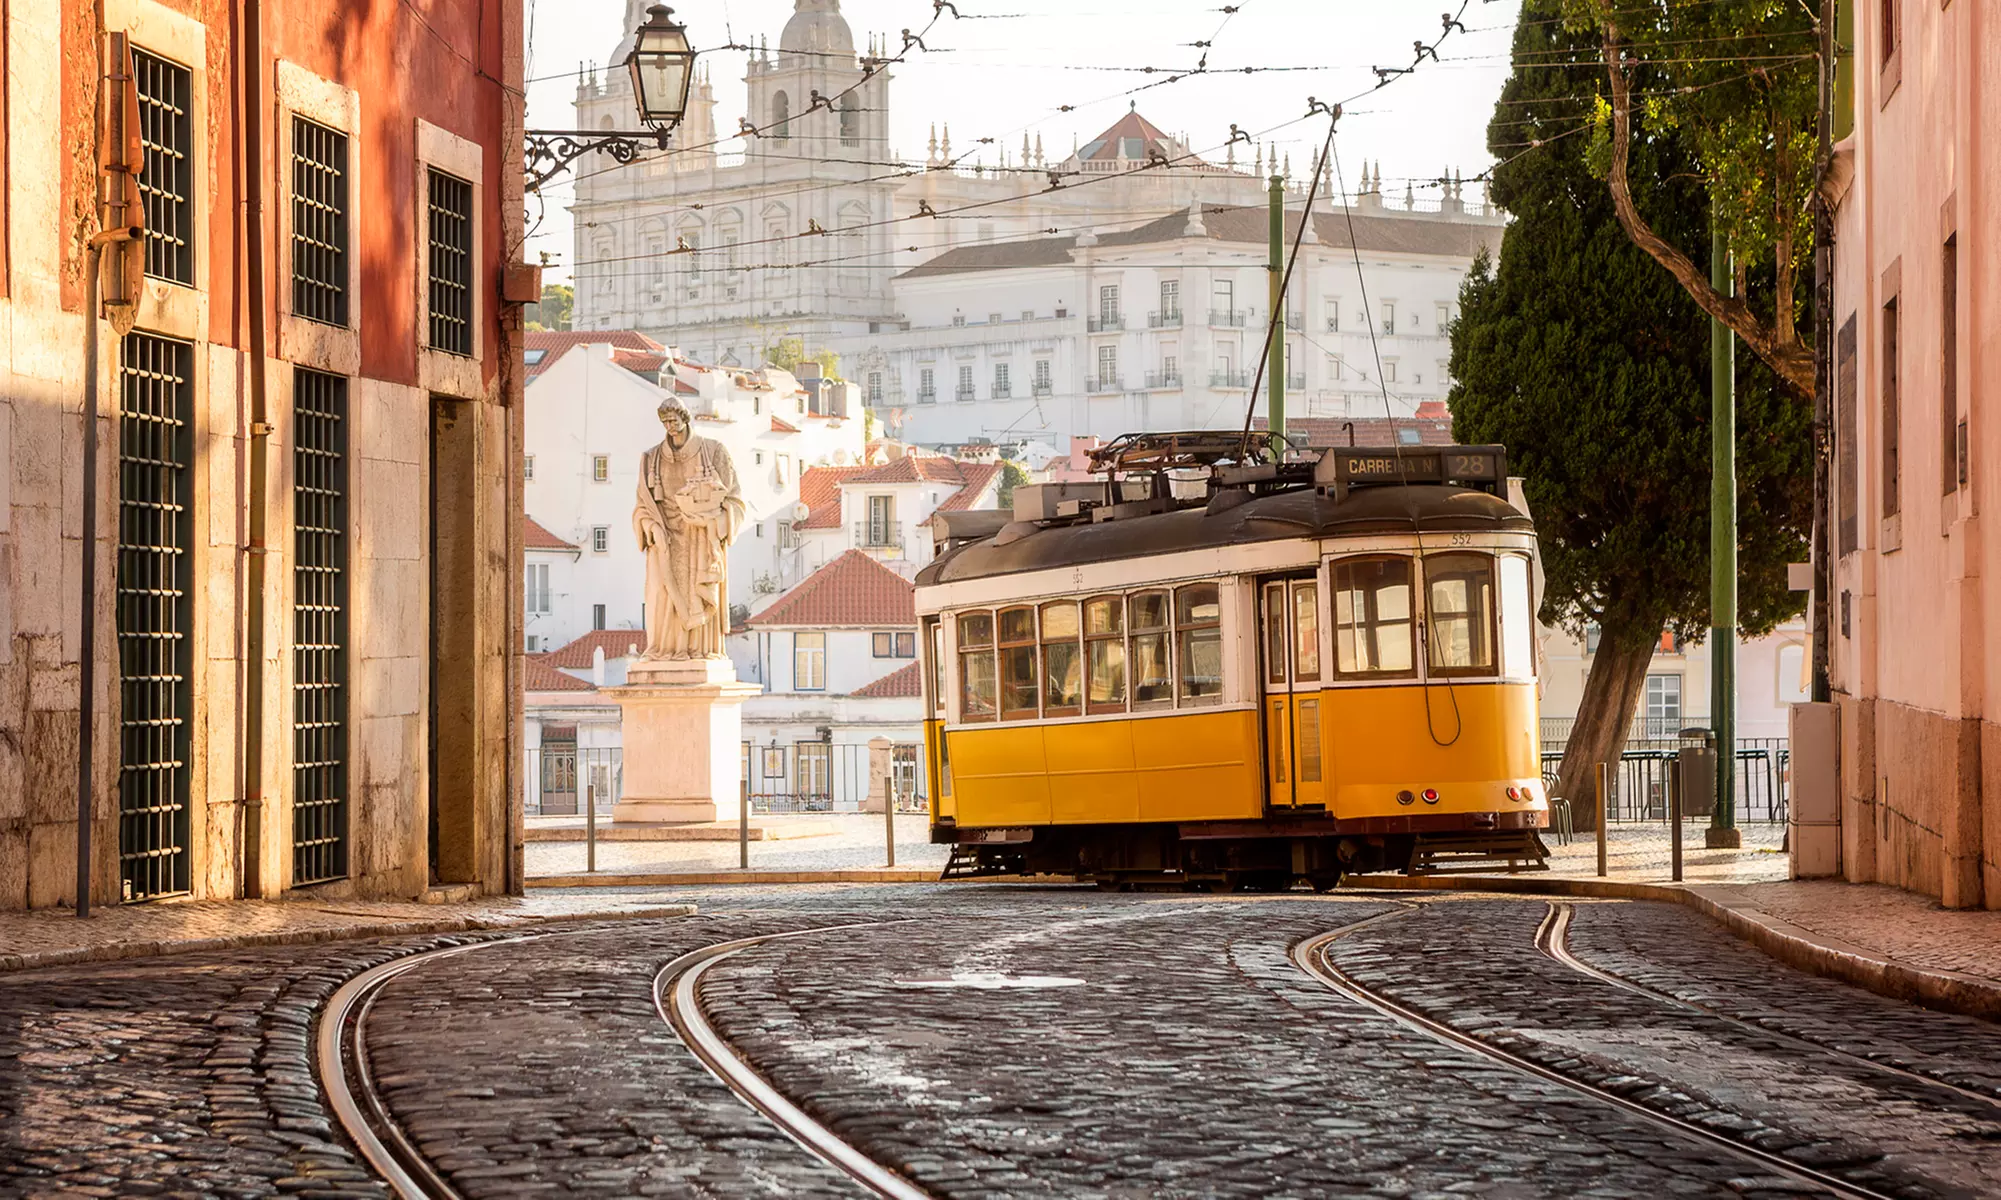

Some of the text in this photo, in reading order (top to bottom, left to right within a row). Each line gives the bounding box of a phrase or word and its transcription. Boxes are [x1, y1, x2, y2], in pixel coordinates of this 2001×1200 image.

[1348, 459, 1416, 474] CARREIRA
[1456, 455, 1484, 475] 28
[1452, 533, 1471, 545] 552
